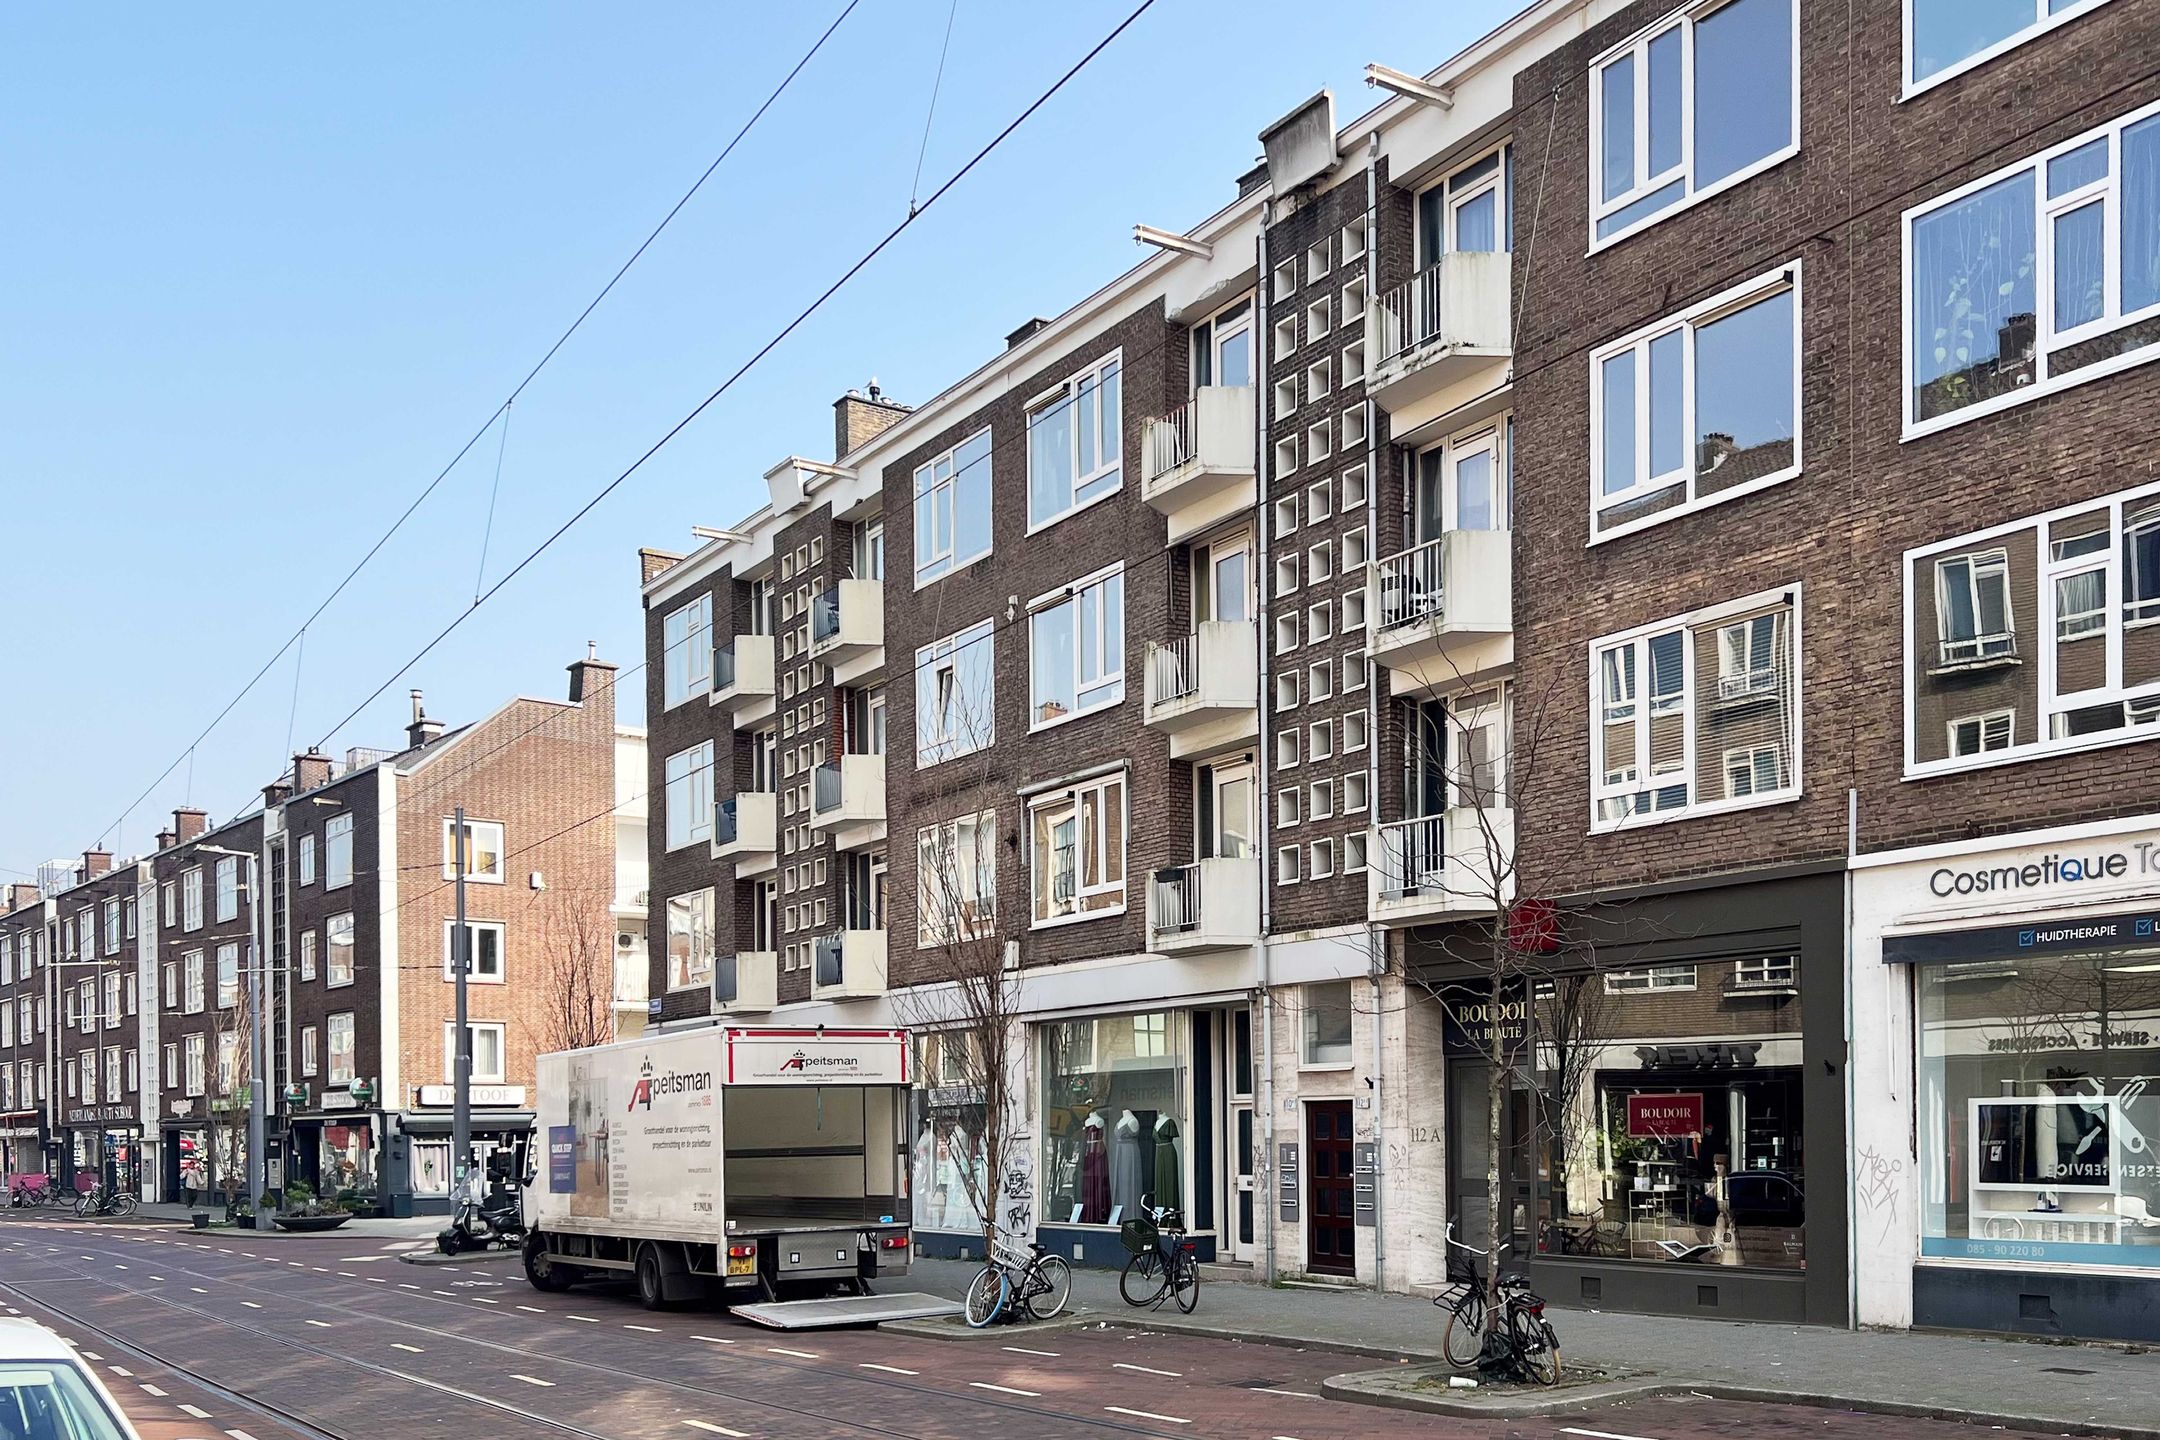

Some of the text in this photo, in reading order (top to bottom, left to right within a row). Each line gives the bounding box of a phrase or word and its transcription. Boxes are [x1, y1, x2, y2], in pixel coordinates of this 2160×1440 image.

[2036, 924, 2118, 943] HUIDTHERAPIE
[805, 1055, 858, 1068] peitsman
[653, 1069, 711, 1101] peitsman
[1641, 1107, 1692, 1119] BOUDOIR
[1410, 1127, 1441, 1143] 112 A
[1966, 1243, 1985, 1255] 085
[1994, 1244, 2007, 1255] 90
[2009, 1245, 2029, 1256] 220
[2031, 1246, 2045, 1257] 80
